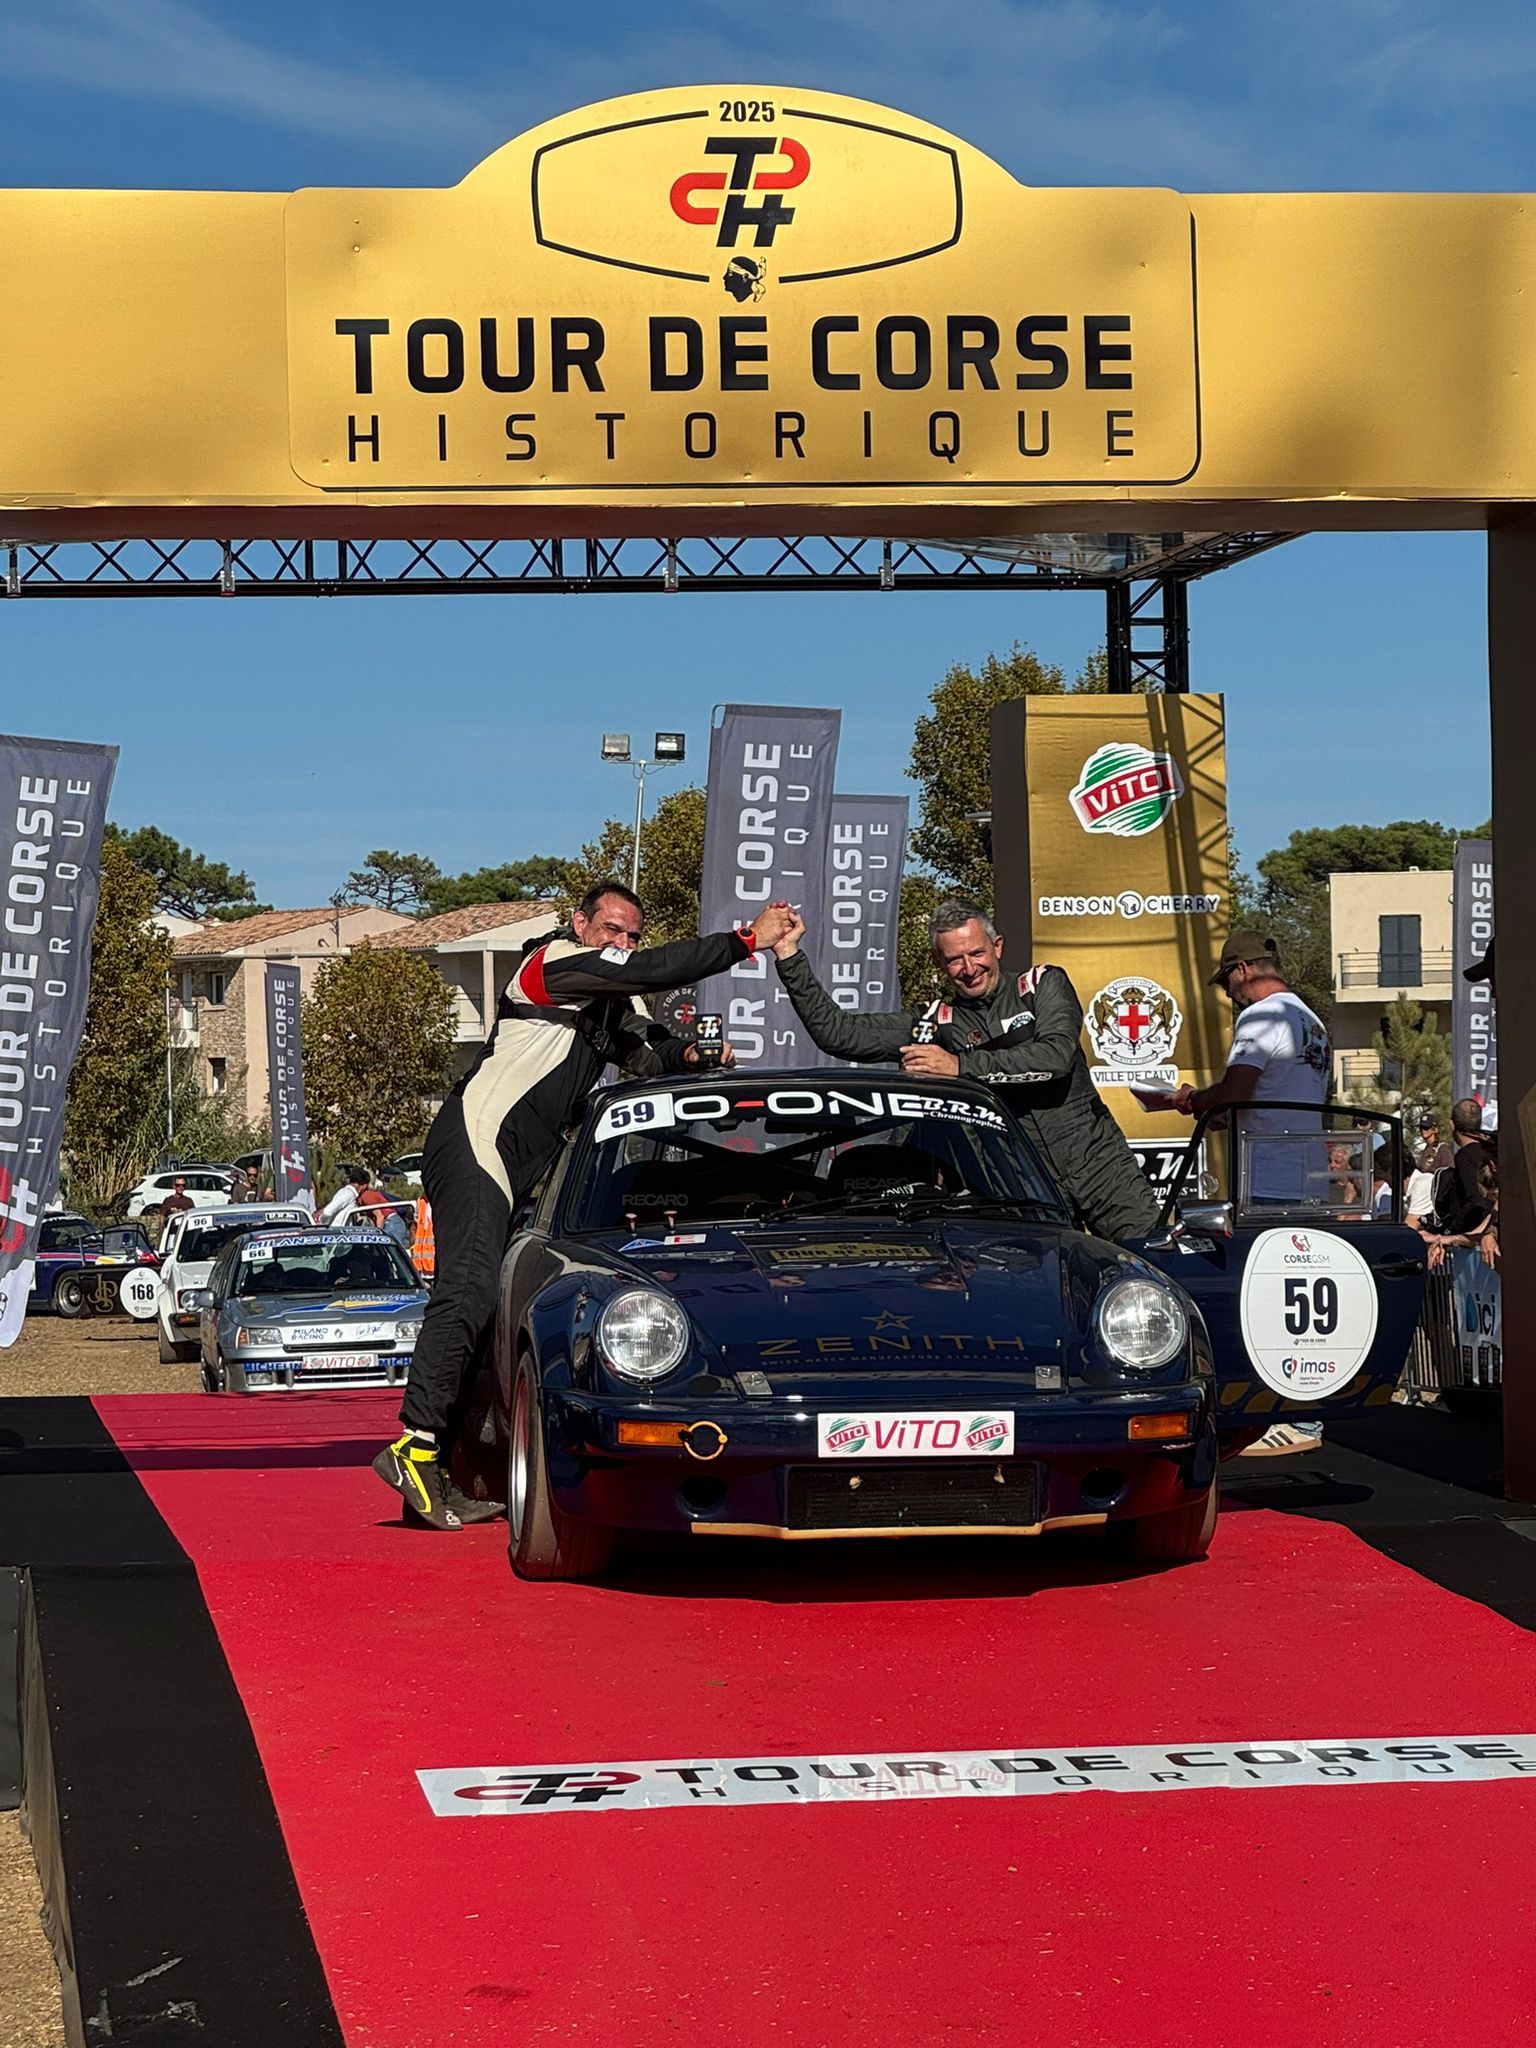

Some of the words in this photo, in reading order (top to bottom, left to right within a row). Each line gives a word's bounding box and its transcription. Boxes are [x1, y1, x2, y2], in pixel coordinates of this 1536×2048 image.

[719, 100, 775, 123] 2025
[334, 317, 608, 394] TOUR
[648, 315, 769, 391] DE
[811, 314, 1133, 391] CORSE
[347, 409, 1135, 464] HISTORIQUE
[1088, 770, 1163, 812] ViTO
[735, 743, 781, 901] CORSE
[4, 776, 59, 936] CORSE
[832, 823, 863, 949] CORSE
[1041, 899, 1114, 916] BENSON
[1145, 895, 1219, 913] CHERRY
[26, 779, 91, 1154] HISTORIQUE
[0, 951, 39, 1013] DE
[274, 979, 286, 1048] CORSE
[286, 980, 302, 1142] HISTORIQUE
[1470, 1013, 1490, 1090] TOUR
[277, 1055, 287, 1081] DE
[1094, 1072, 1124, 1082] VILLE
[1127, 1071, 1141, 1082] DE
[1145, 1070, 1175, 1081] CALVI
[610, 1101, 655, 1129] 59
[844, 1177, 909, 1190] RECARO
[622, 1194, 688, 1206] RECARO
[194, 1218, 207, 1226] 96
[249, 1249, 266, 1258] 66
[323, 1234, 391, 1244] RACING
[131, 1284, 154, 1300] 168
[1284, 1277, 1338, 1335] 59
[1475, 1292, 1496, 1337] ici
[294, 1327, 329, 1335] MILANO
[757, 1335, 1024, 1356] ZENITH
[1300, 1357, 1336, 1373] imas
[875, 1420, 961, 1449] ViTO
[655, 1760, 951, 1783] TOUR
[990, 1753, 1130, 1774] DE
[1166, 1743, 1523, 1768] CORSE
